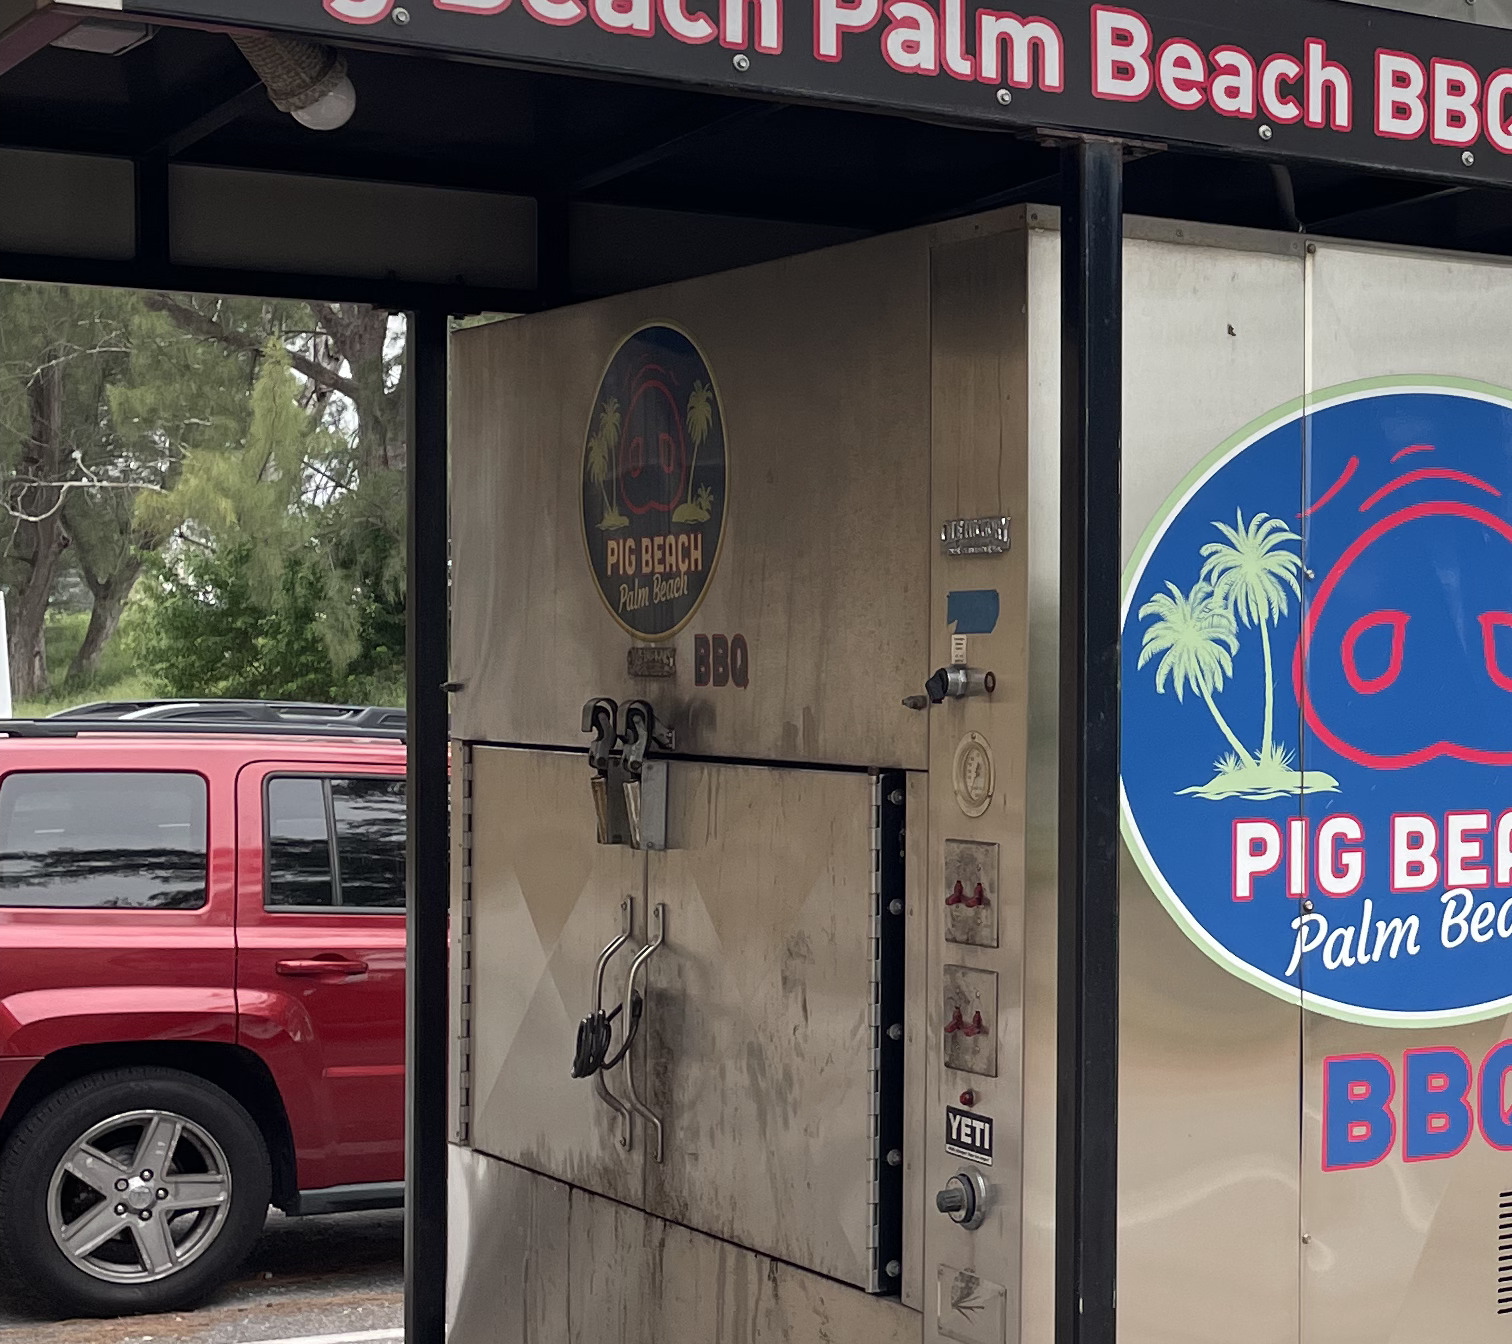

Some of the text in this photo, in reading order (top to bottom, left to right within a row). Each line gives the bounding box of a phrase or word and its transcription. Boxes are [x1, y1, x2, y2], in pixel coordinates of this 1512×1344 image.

[1091, 4, 1352, 132] Beach
[607, 532, 702, 577] PIG BEACH
[618, 572, 689, 614] Palm Beach
[694, 633, 750, 690] BBQ
[1231, 813, 1366, 902] PIG
[1284, 899, 1421, 976] Palm
[948, 1111, 990, 1149] YETI
